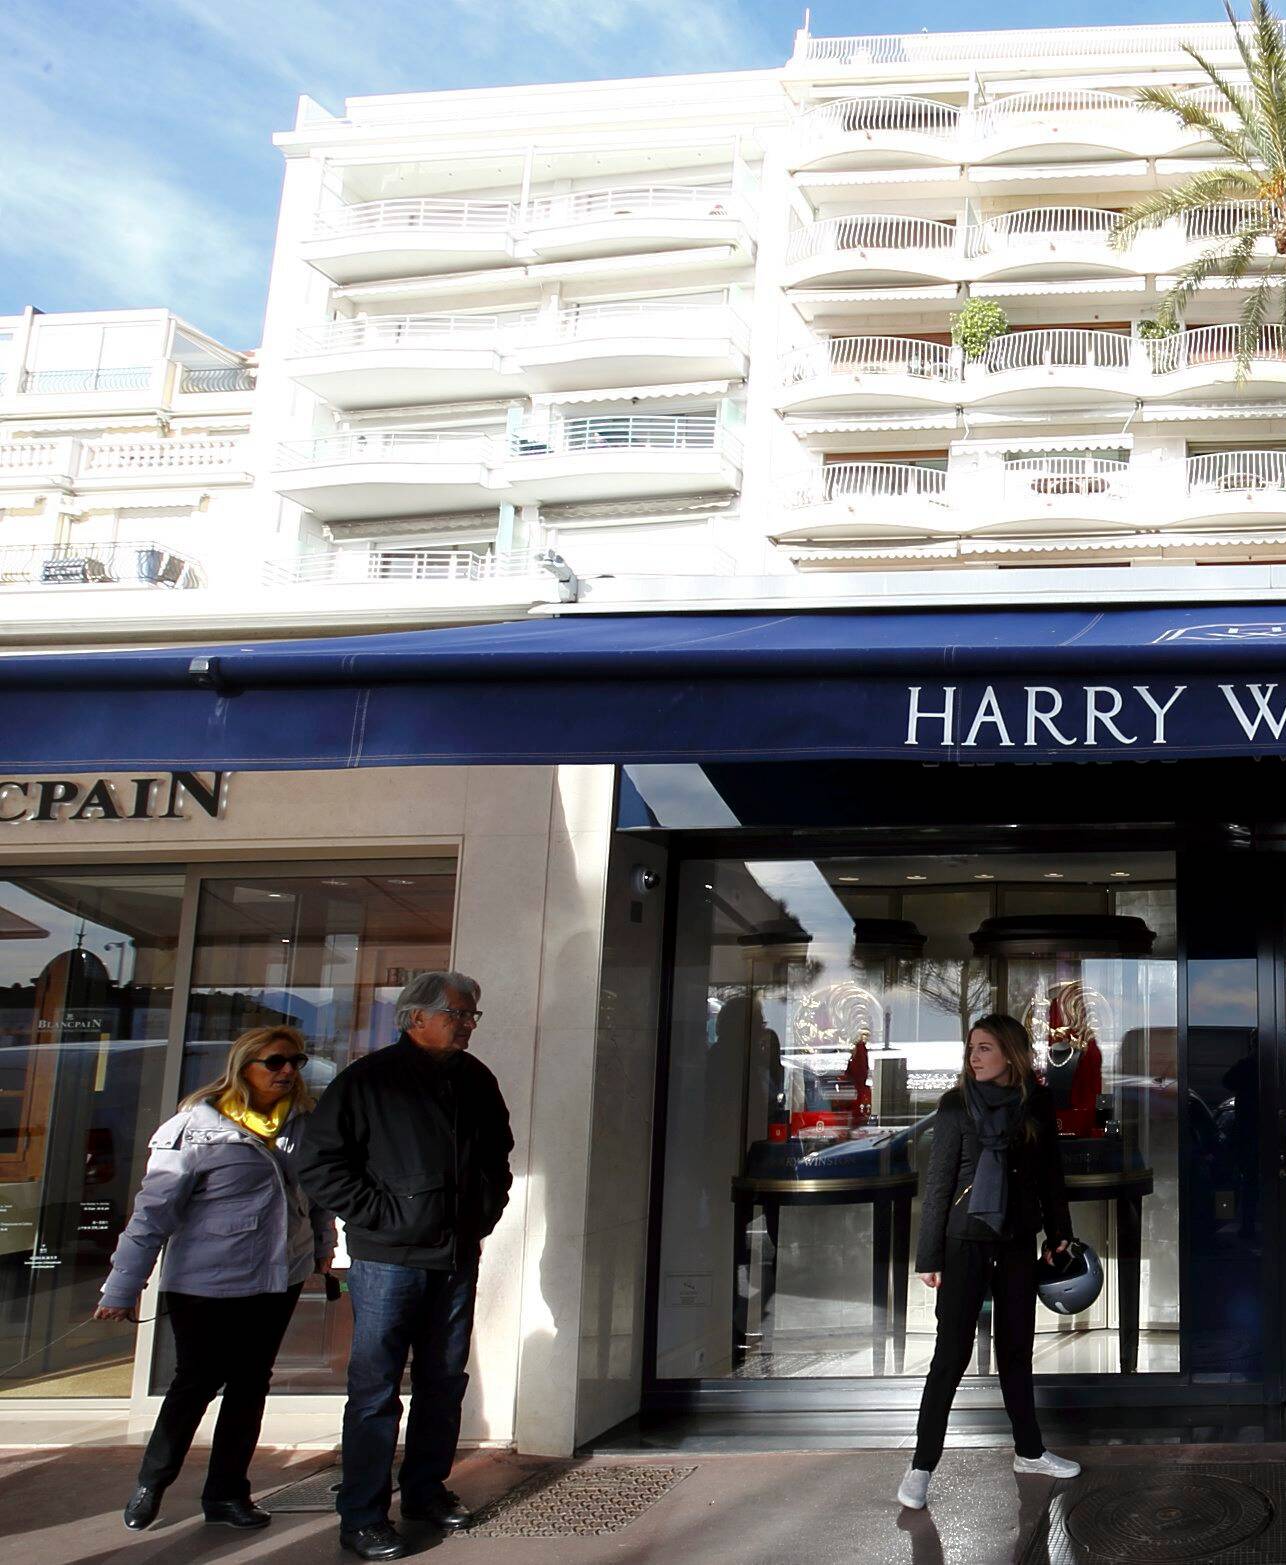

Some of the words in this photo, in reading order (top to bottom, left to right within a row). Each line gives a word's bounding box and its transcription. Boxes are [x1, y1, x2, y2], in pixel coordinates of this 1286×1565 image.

[904, 685, 1187, 747] HARRY
[0, 770, 223, 821] CPAIN
[37, 1018, 102, 1030] BLANCPAIN
